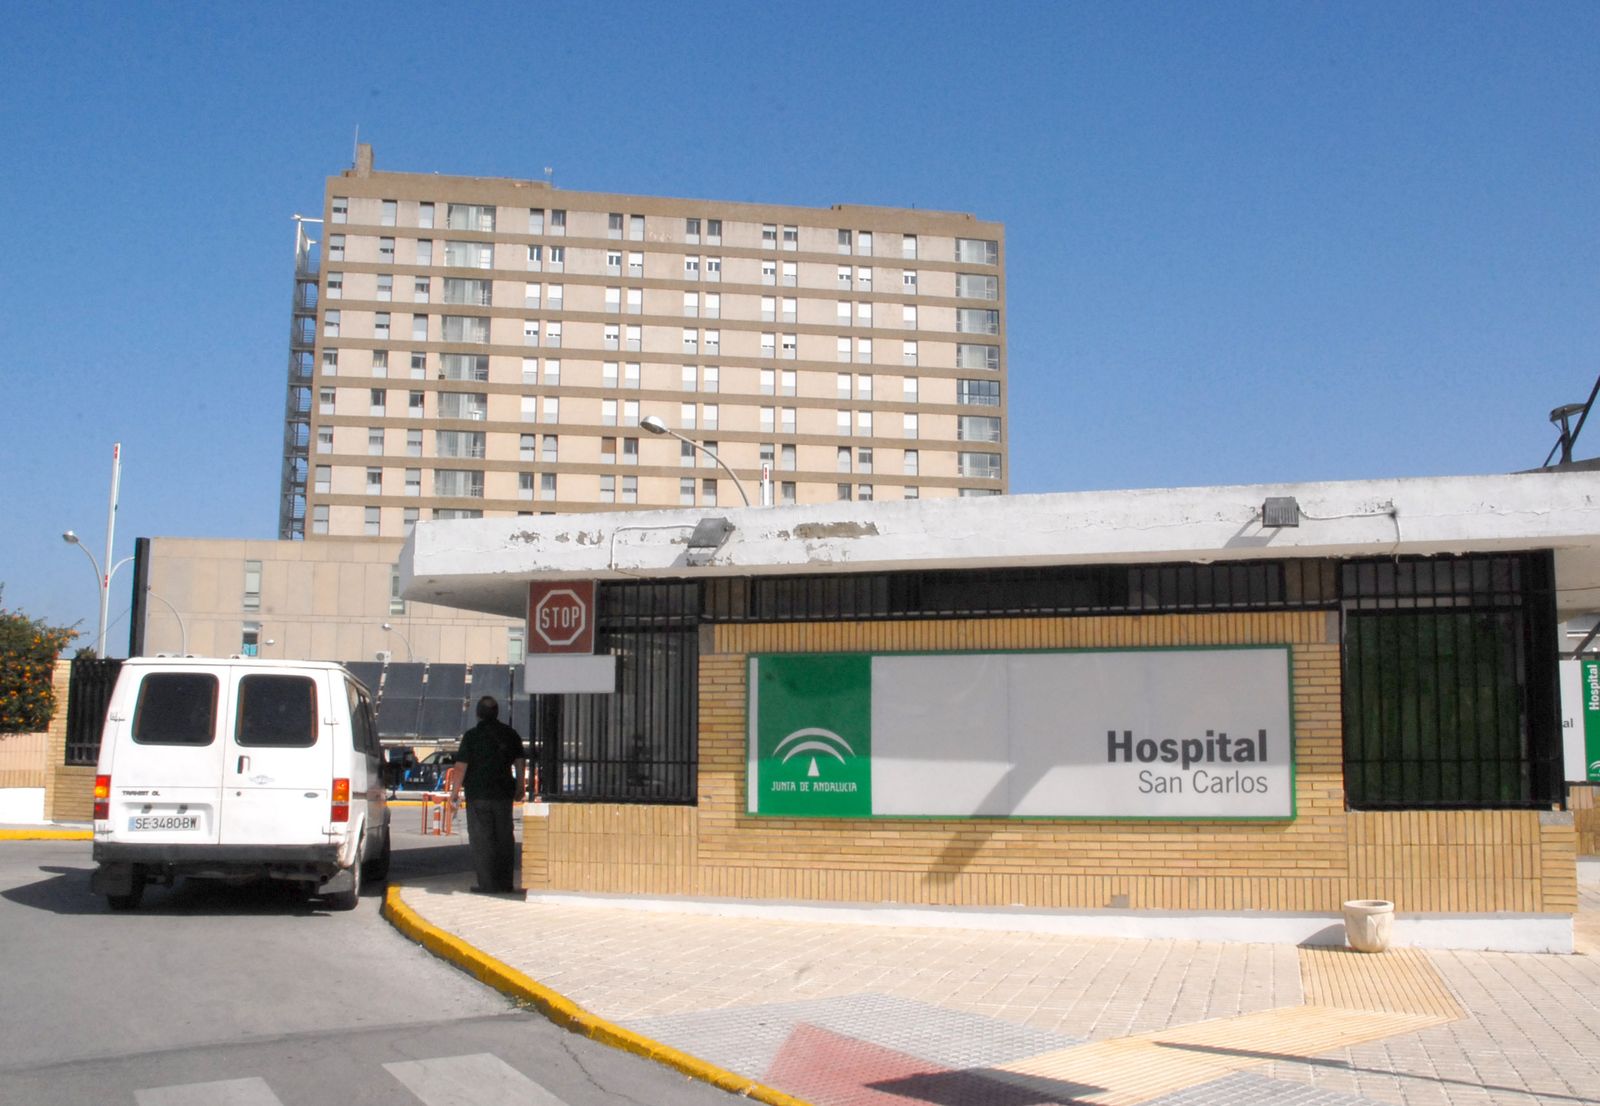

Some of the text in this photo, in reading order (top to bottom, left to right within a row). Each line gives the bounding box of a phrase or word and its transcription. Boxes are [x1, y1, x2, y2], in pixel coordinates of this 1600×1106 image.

[541, 606, 580, 629] STOP
[1587, 664, 1600, 710] Hospital
[1107, 729, 1268, 771] Hospital
[771, 781, 858, 793] JUNTA DE ANDALUCIA
[1138, 770, 1269, 794] San Carlos
